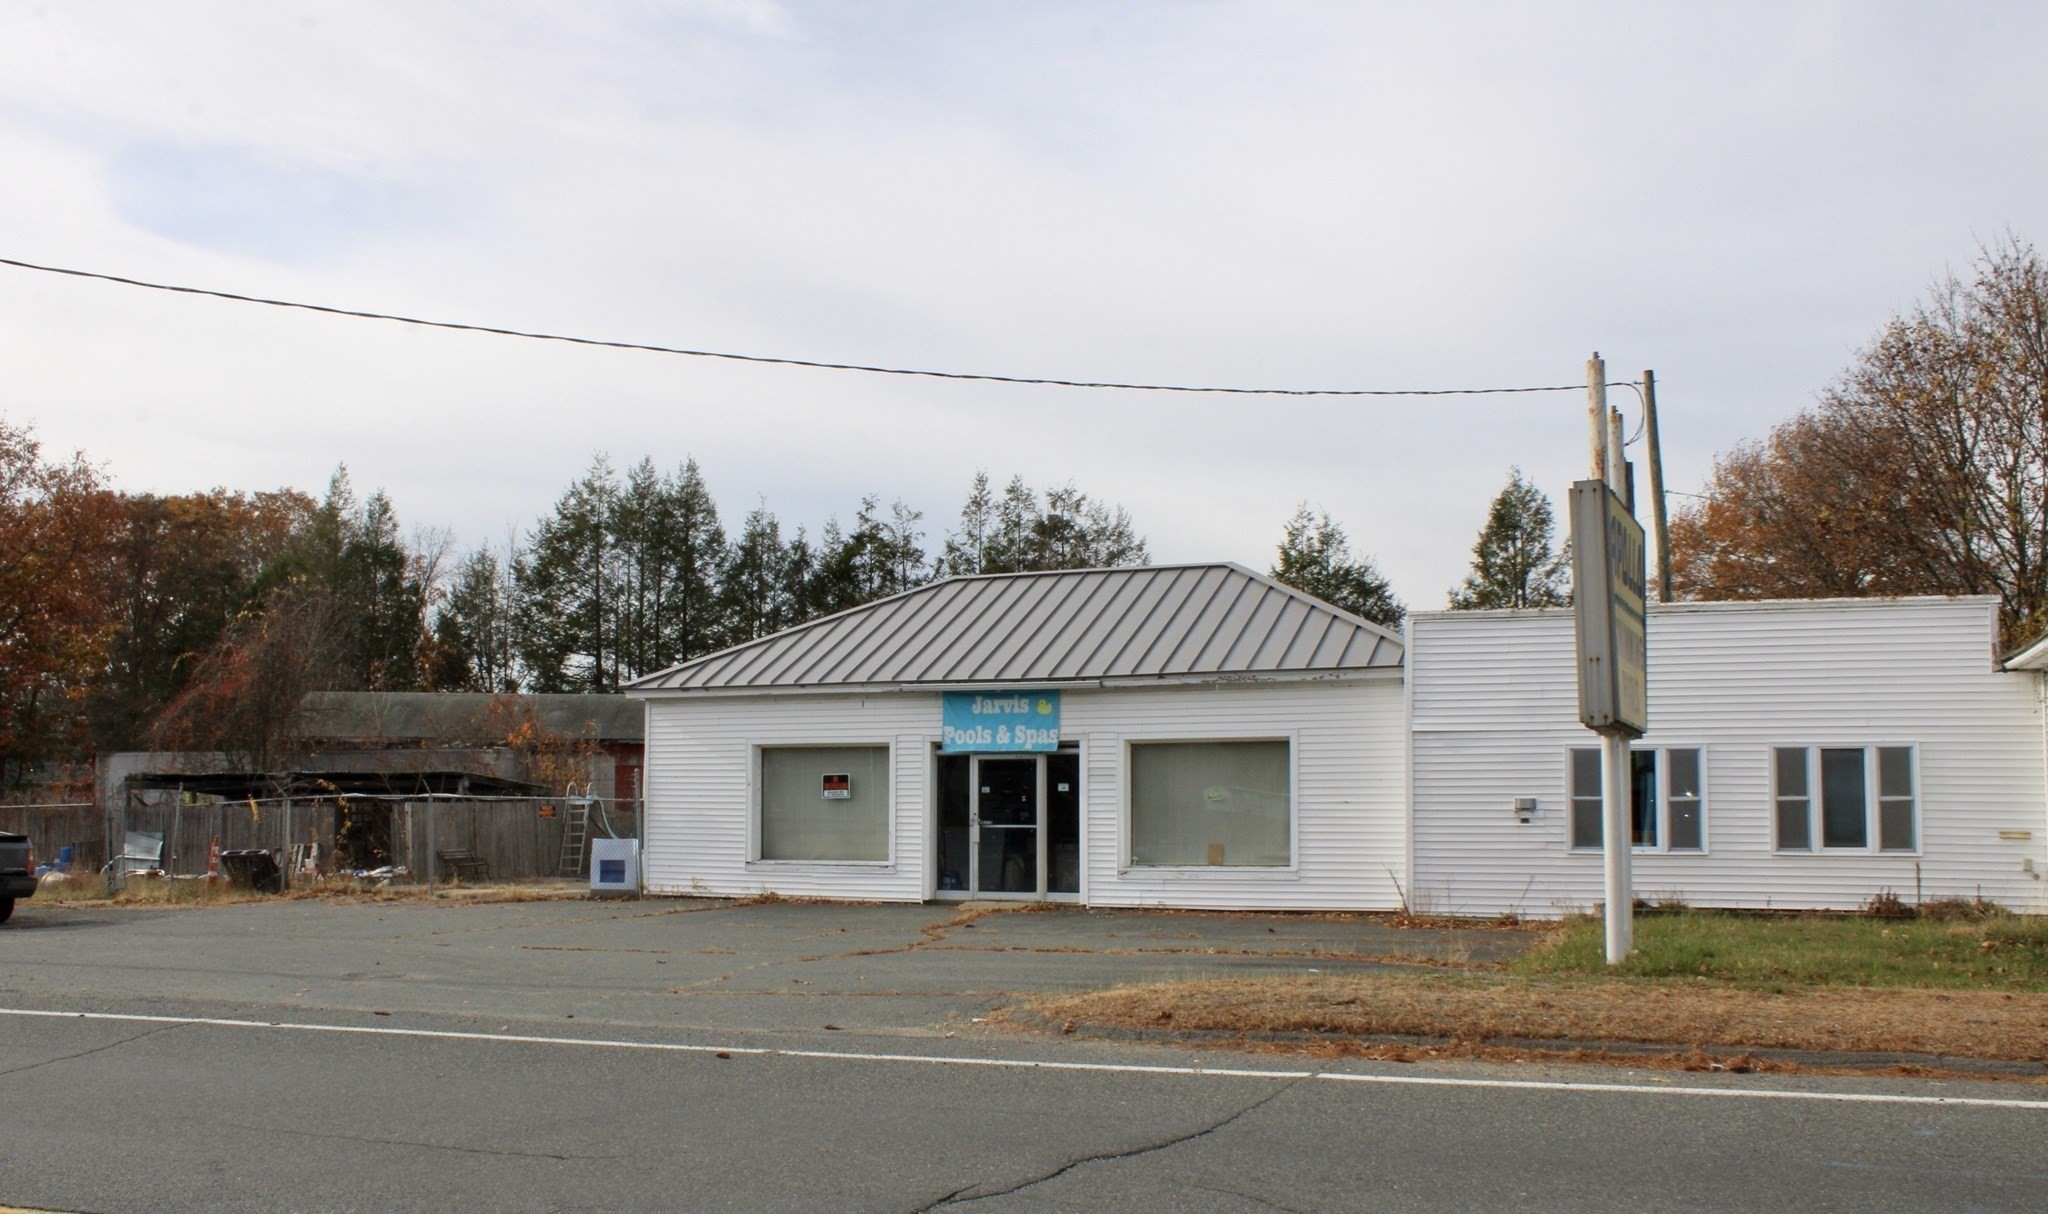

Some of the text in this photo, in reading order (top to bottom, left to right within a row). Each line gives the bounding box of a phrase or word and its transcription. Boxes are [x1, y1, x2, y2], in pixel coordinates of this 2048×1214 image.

[971, 694, 1029, 715] Jarvis
[943, 724, 1058, 749] Pools & Spas
